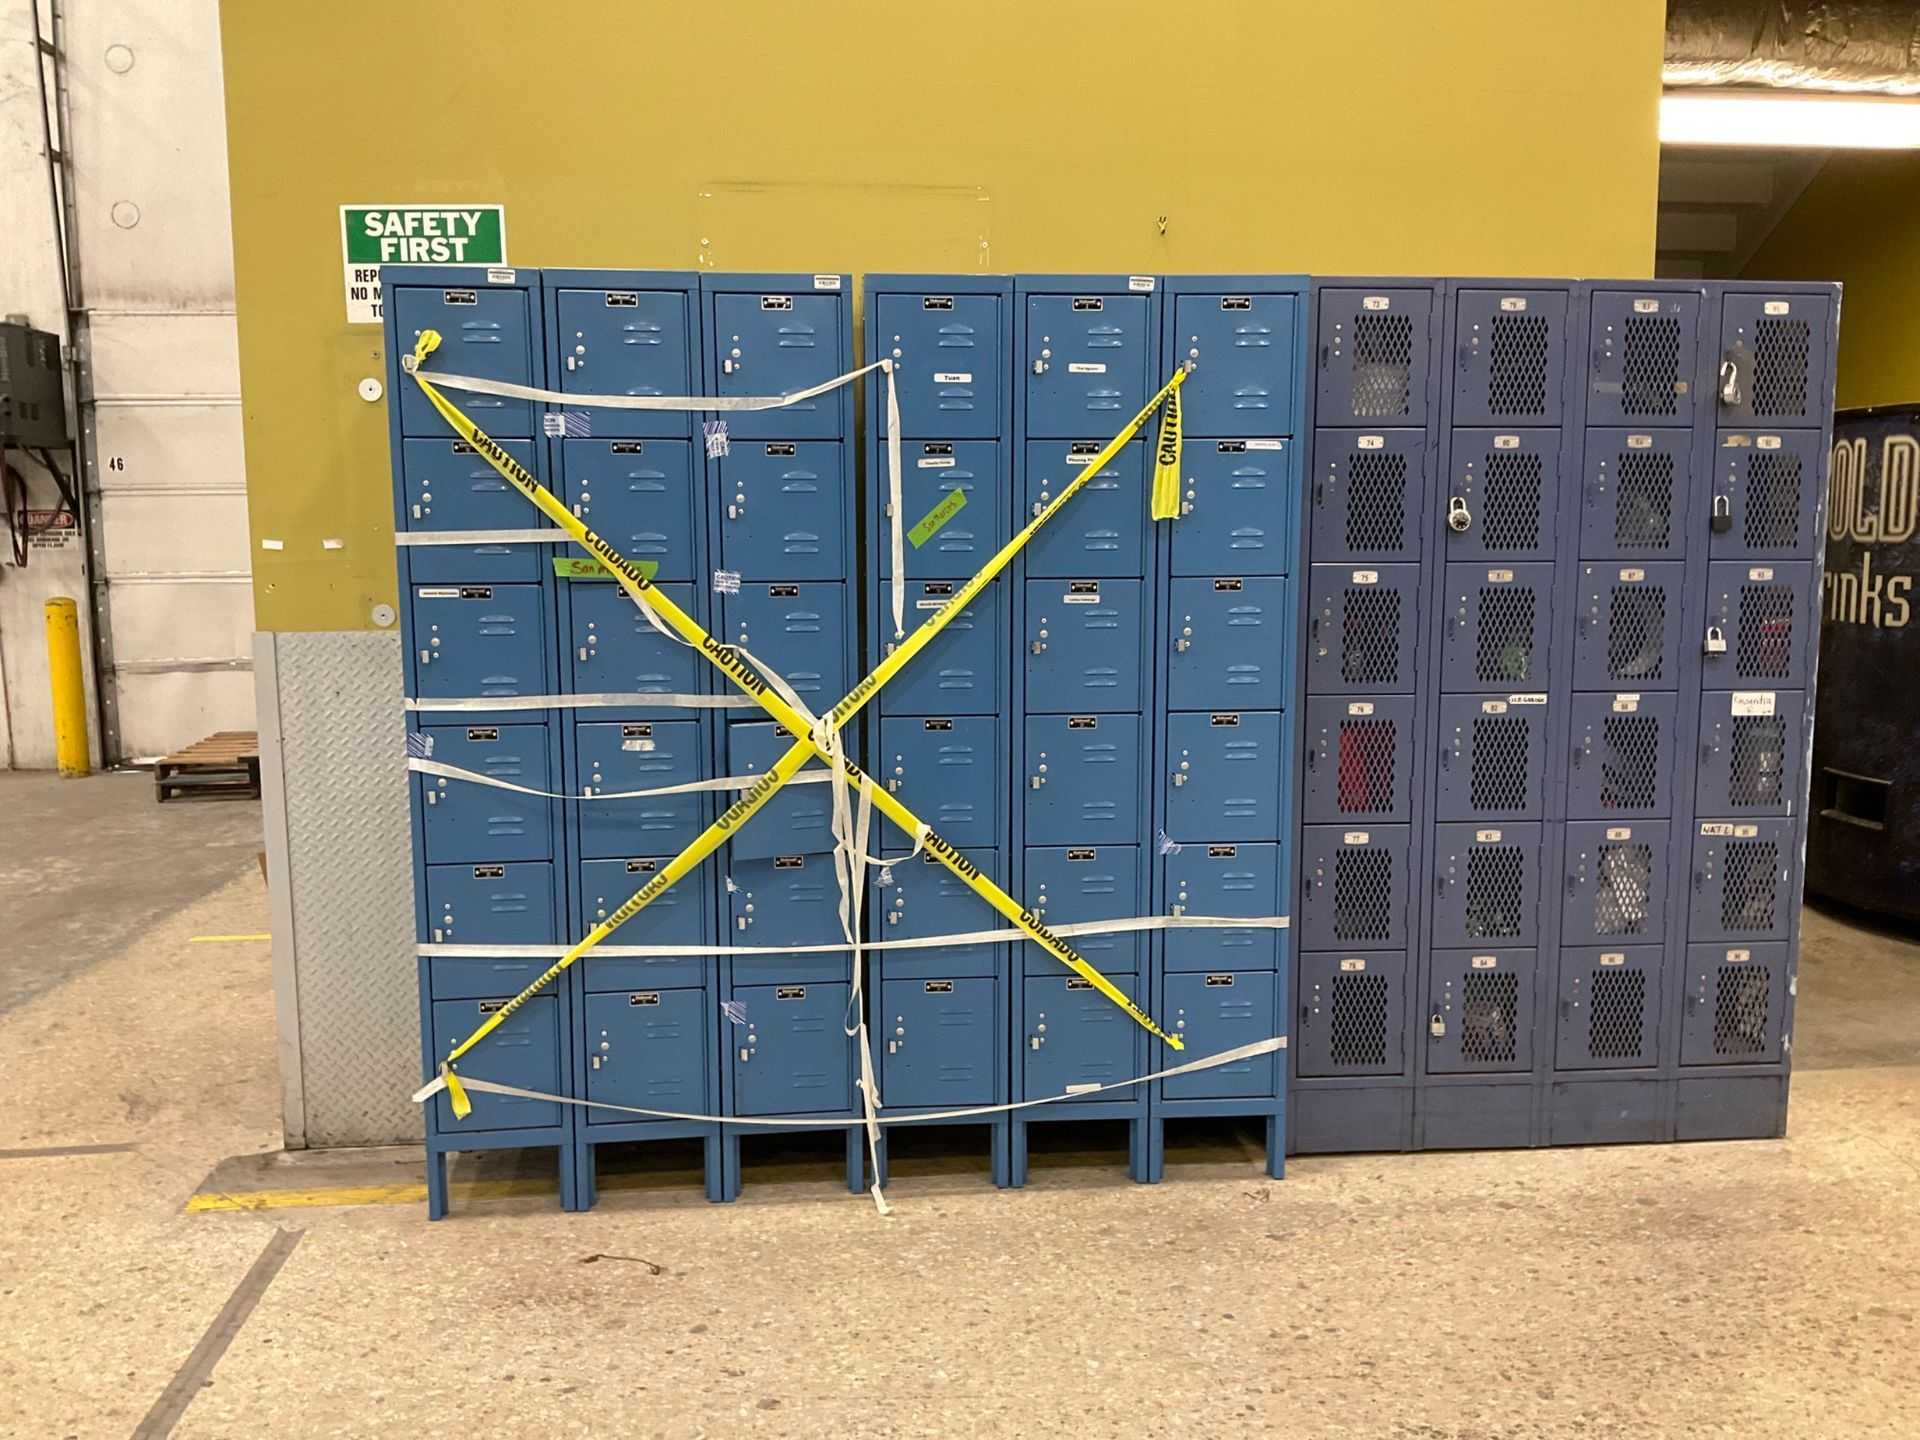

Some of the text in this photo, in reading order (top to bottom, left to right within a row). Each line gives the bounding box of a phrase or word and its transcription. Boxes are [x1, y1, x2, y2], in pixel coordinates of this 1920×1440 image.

[364, 211, 482, 237] SAFETY
[380, 237, 469, 262] FIRST
[355, 269, 381, 283] REP
[351, 287, 368, 300] NO
[109, 457, 124, 472] 46
[1830, 435, 1920, 543] OLD
